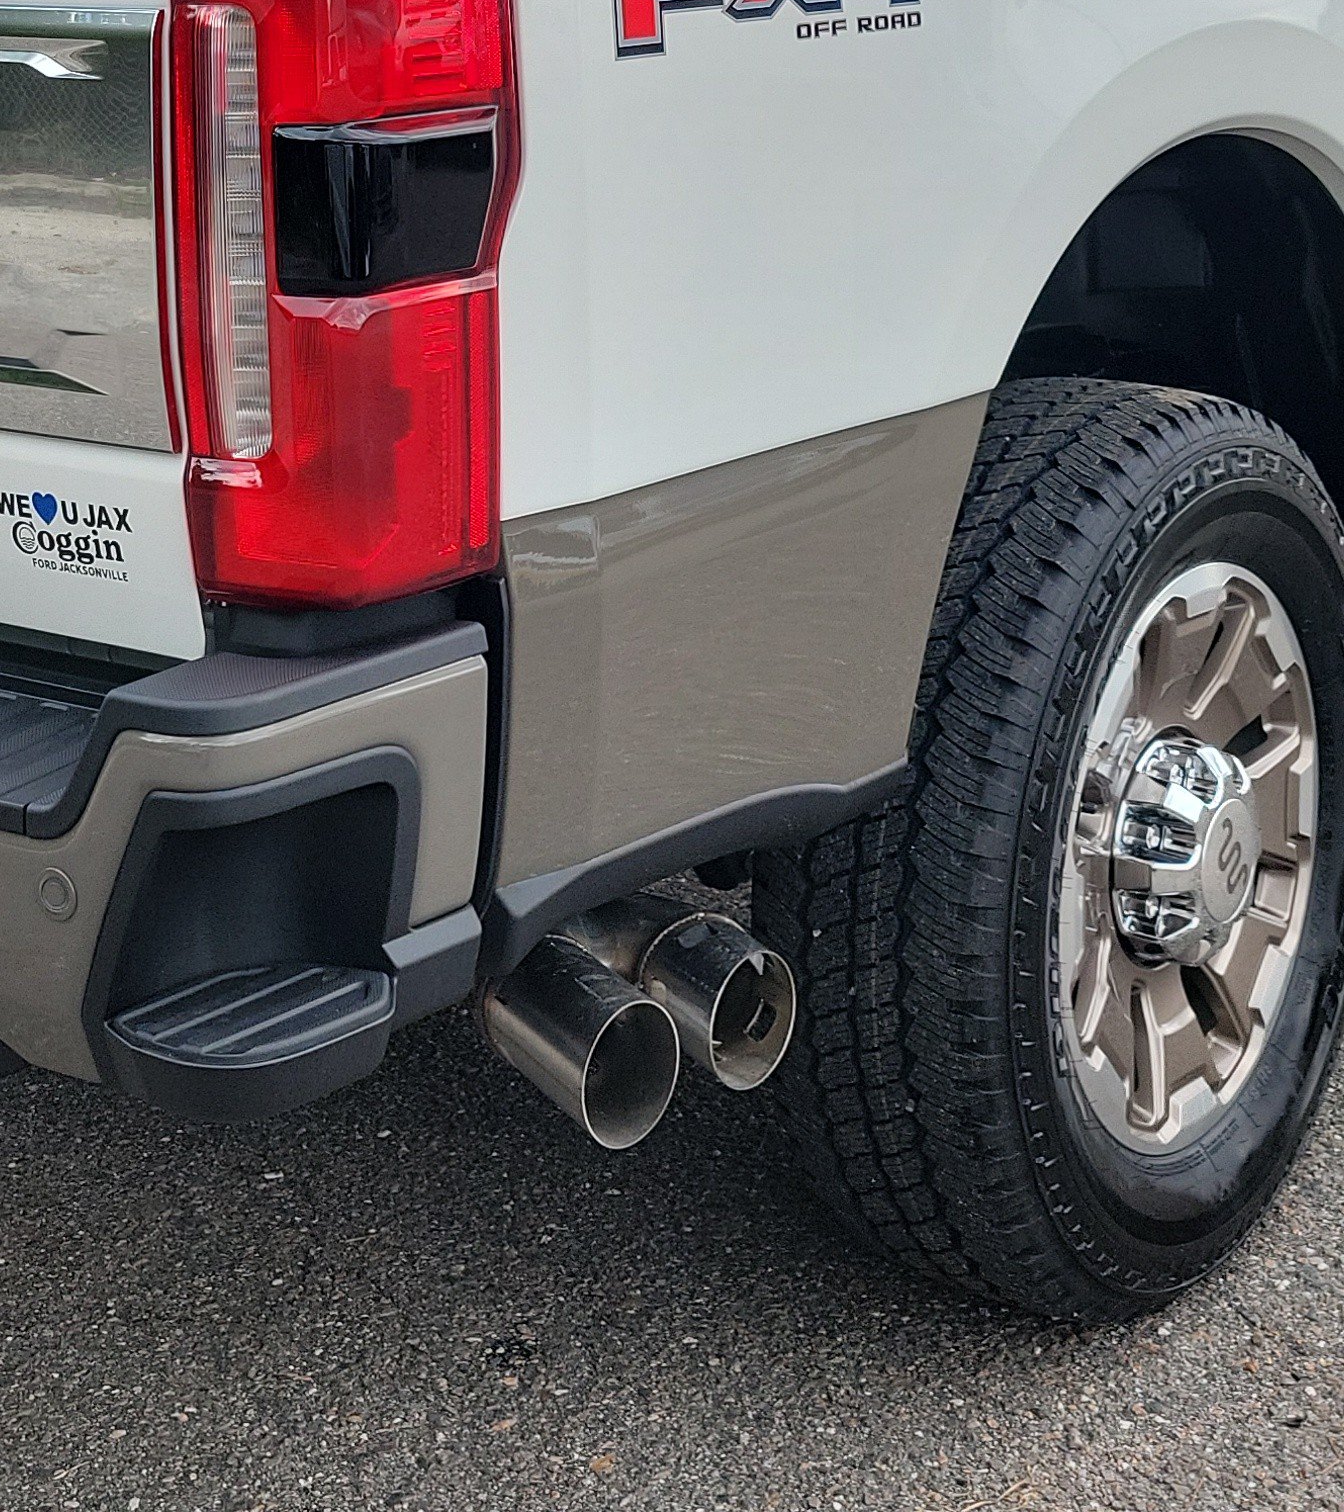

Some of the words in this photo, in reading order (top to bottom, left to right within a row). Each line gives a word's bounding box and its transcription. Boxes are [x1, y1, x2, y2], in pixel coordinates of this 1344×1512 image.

[796, 17, 848, 39] OFF
[857, 11, 922, 34] ROAD
[60, 500, 79, 525] U
[83, 504, 133, 533] JAX
[12, 520, 125, 565] Coggin
[32, 558, 58, 571] FORD
[59, 562, 129, 582] JACKSONVILLE
